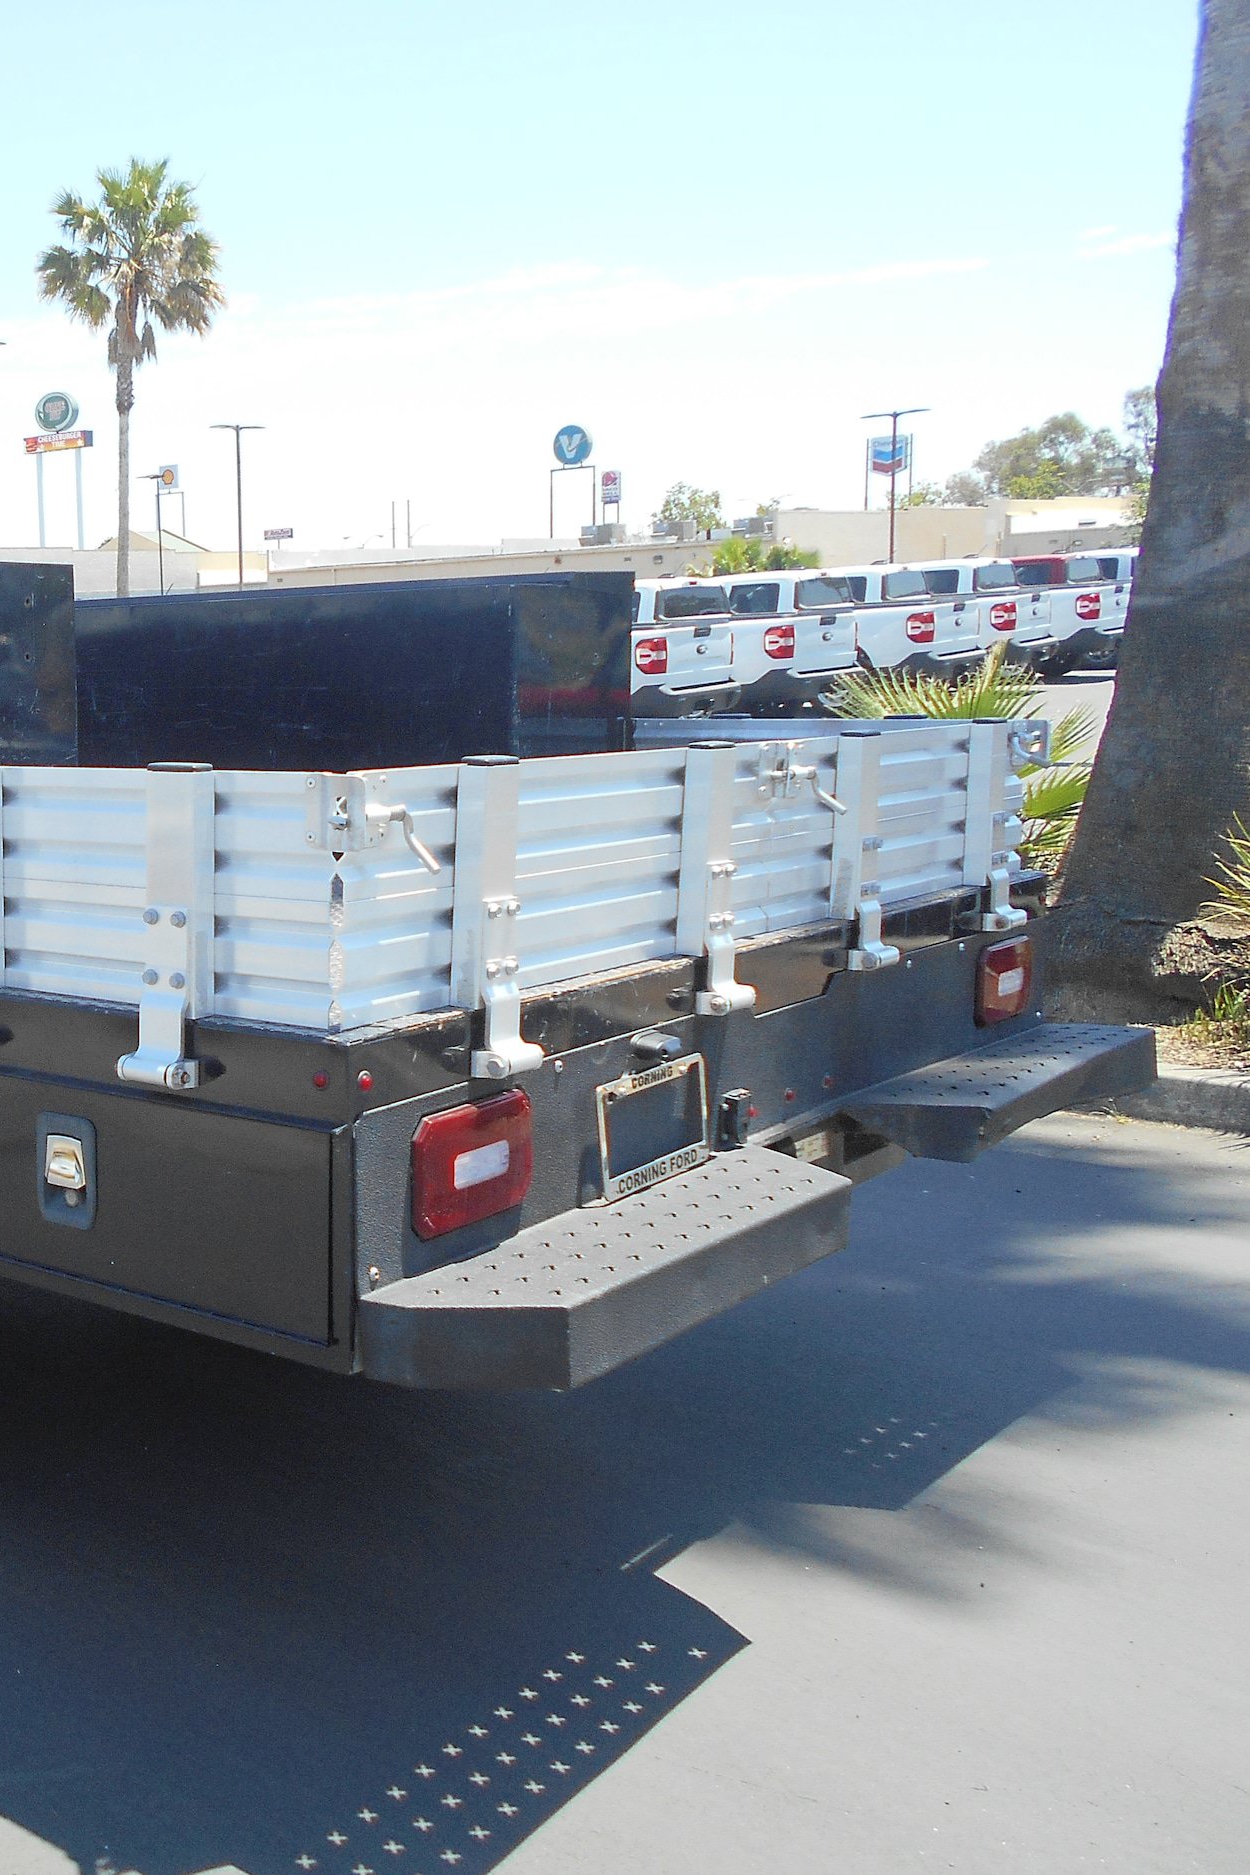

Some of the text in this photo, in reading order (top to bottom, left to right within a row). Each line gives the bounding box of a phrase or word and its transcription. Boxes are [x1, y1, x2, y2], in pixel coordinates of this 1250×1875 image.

[38, 431, 82, 443] CHEESEBURGER
[630, 1065, 674, 1090] CORNING
[617, 1148, 698, 1194] CORNING FORD
